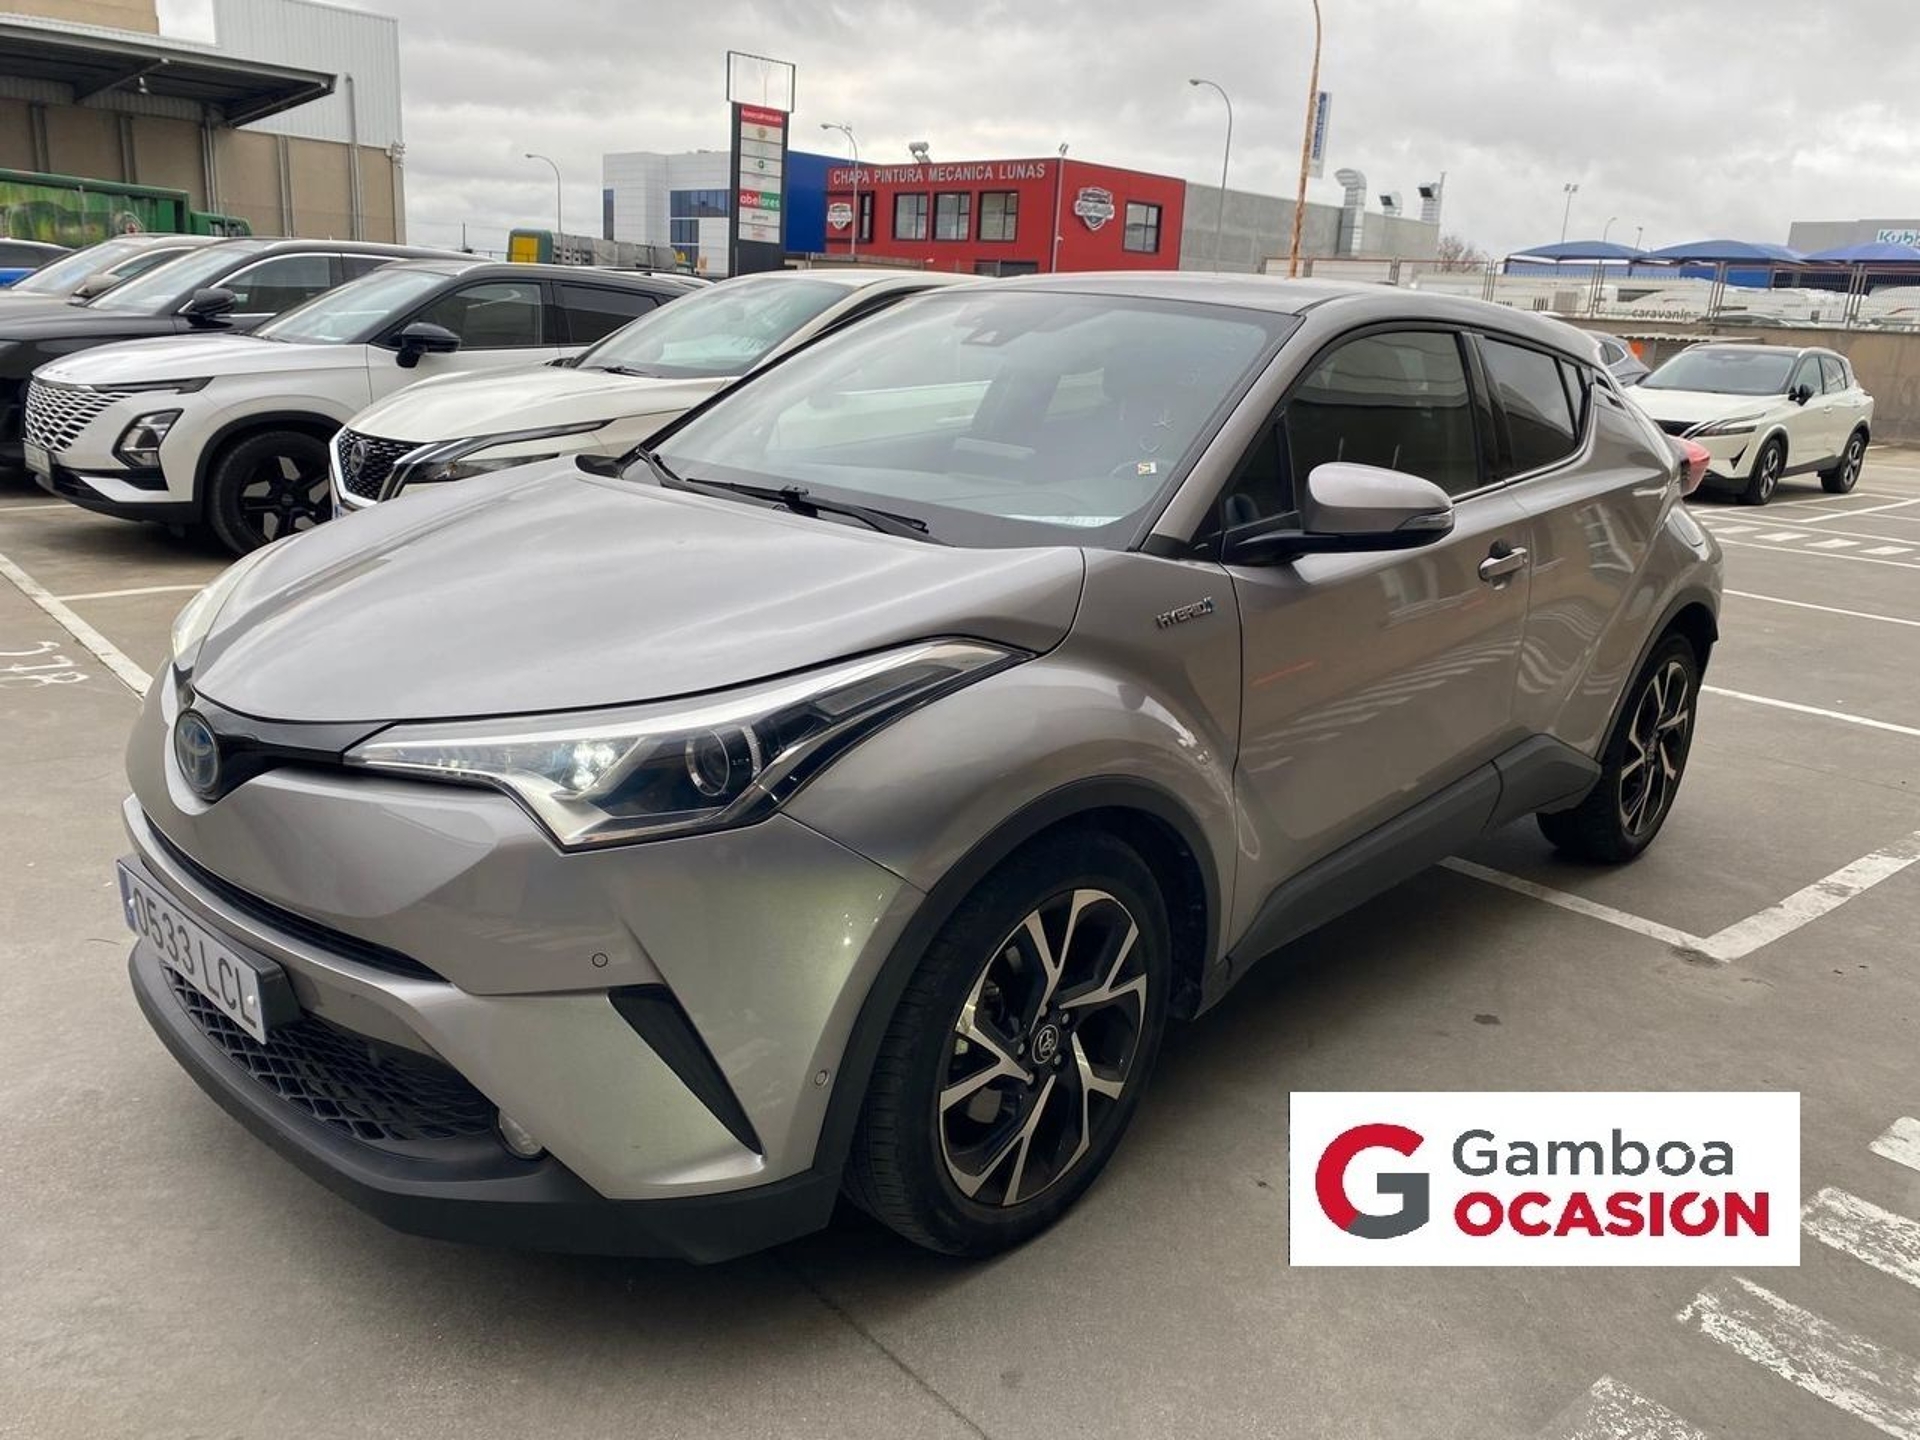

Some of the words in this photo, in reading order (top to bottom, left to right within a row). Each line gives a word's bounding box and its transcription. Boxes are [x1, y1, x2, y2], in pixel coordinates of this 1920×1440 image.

[833, 169, 870, 185] CHAPA
[874, 167, 924, 184] PINTURA
[928, 164, 994, 182] MECANICA
[999, 162, 1046, 180] LUNAS
[1156, 598, 1208, 628] HYBRID
[134, 887, 195, 976] 0533
[199, 940, 258, 1030] LCL
